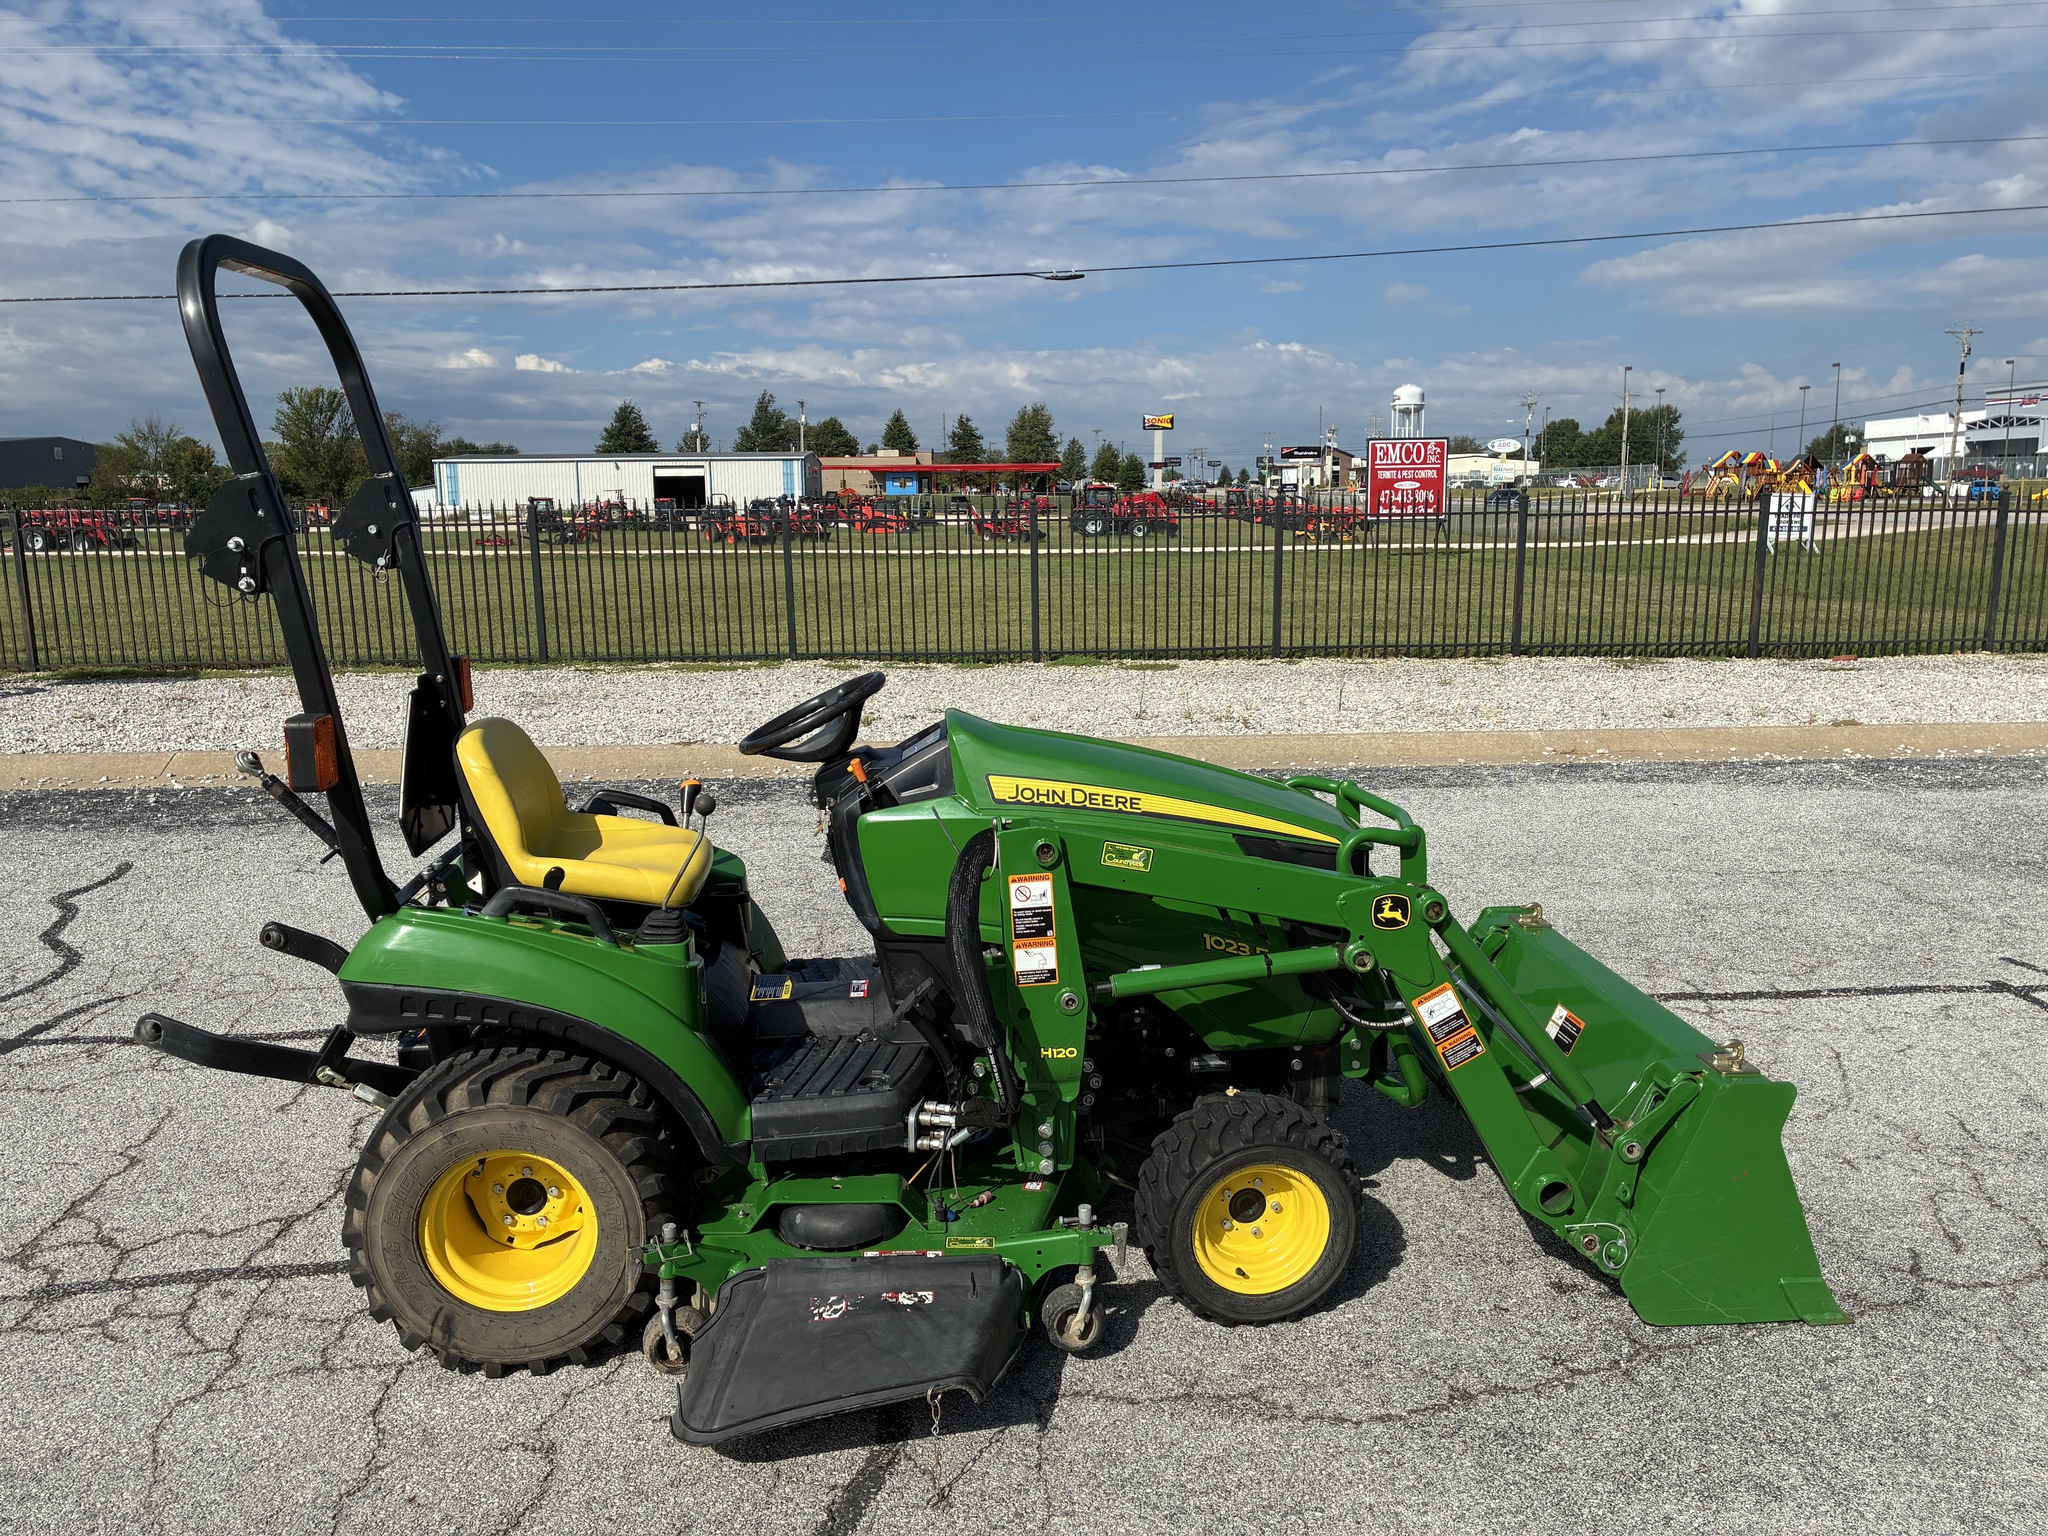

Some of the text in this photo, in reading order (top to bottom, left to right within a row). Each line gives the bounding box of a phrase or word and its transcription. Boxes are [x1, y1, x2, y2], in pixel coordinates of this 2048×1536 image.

[1146, 417, 1172, 425] SONIC
[1374, 442, 1441, 464] EMCO INC.
[1377, 469, 1438, 479] TERMITE & PEST CONTROL
[1008, 784, 1142, 811] JOHN DEERE
[1017, 874, 1050, 883] WARNING
[1021, 940, 1054, 948] WARNING
[1202, 932, 1251, 956] 1023
[1423, 985, 1448, 1002] WARNING
[1448, 1031, 1472, 1047] WARNING
[1040, 1047, 1078, 1059] H120
[386, 1164, 420, 1298] TRAC CHIEF
[584, 1175, 626, 1313] CARLISLE
